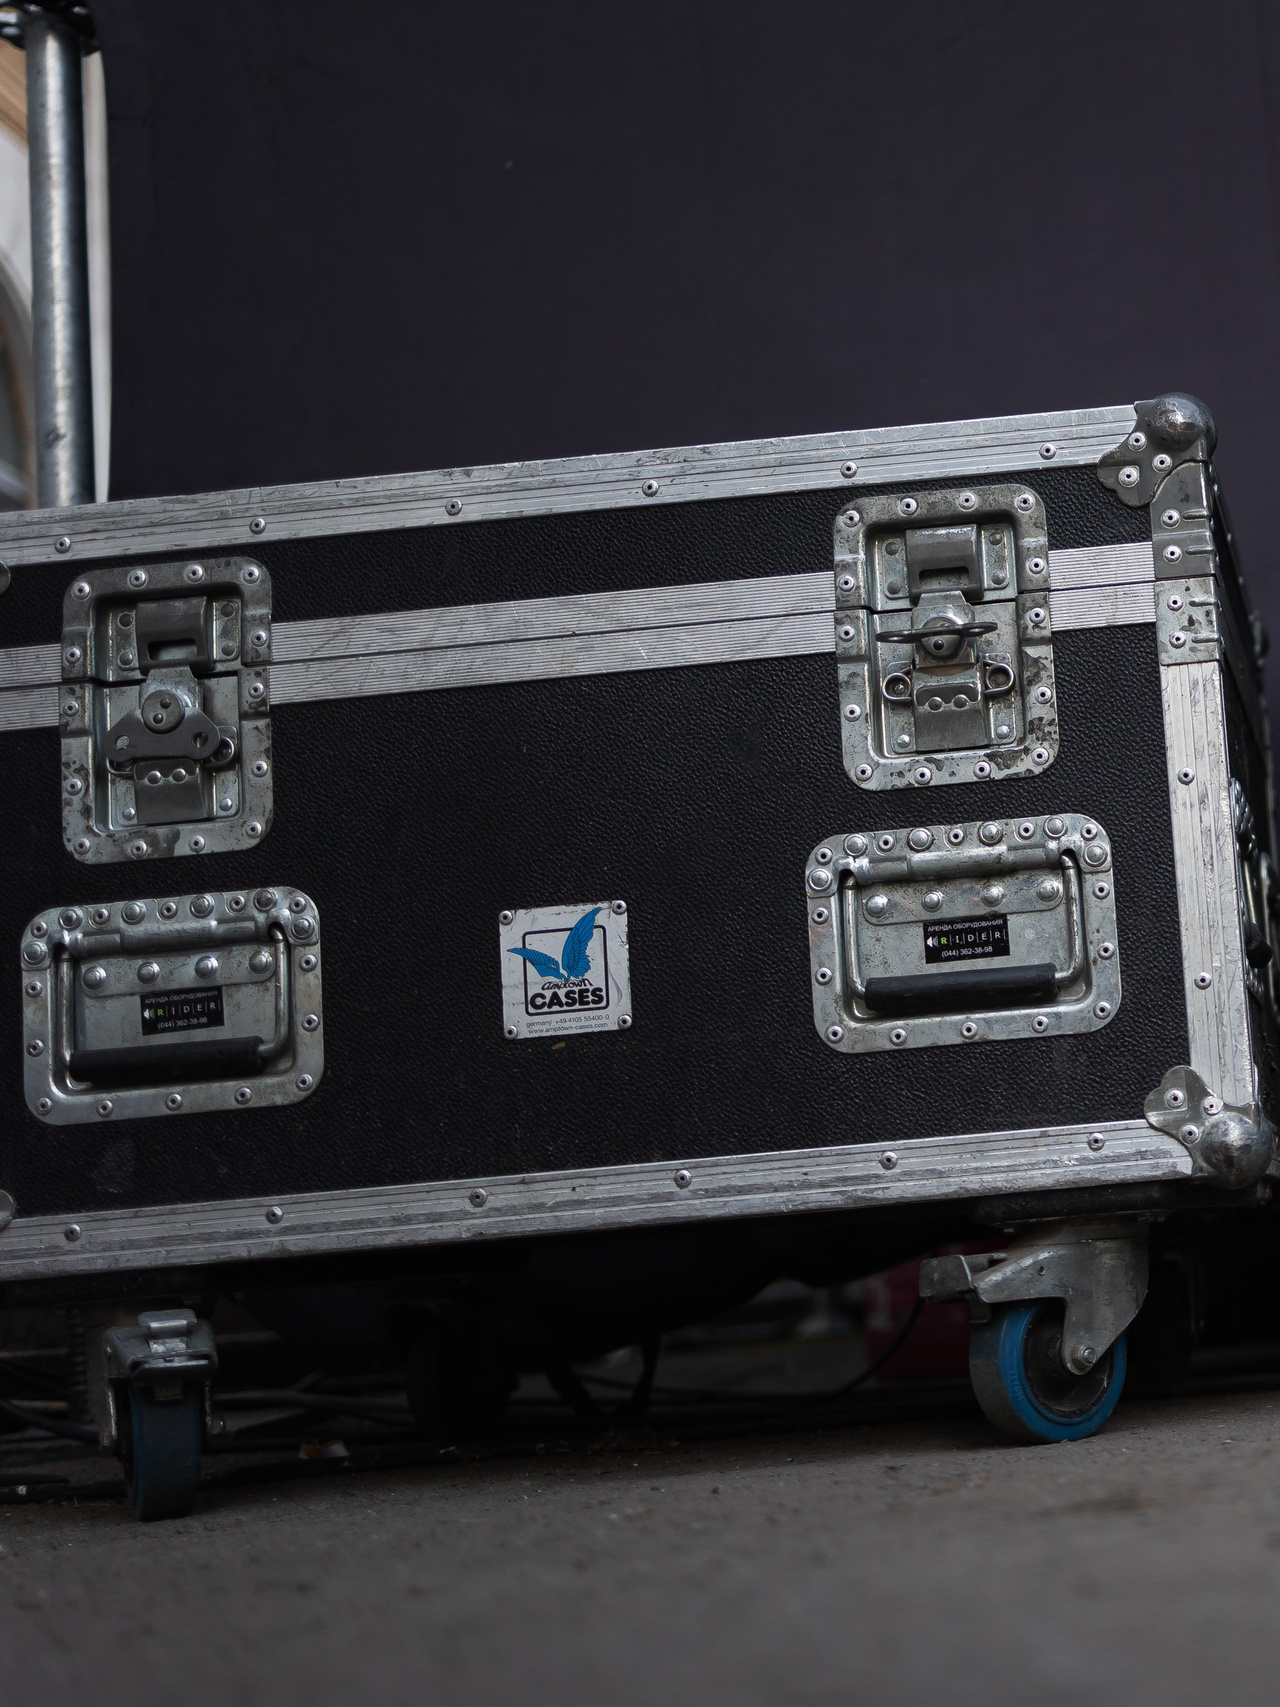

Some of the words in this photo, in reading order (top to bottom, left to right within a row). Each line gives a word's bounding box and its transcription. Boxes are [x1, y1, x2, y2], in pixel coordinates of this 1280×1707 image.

[927, 924, 952, 932] АРЕНДА
[940, 931, 1001, 944] RIDER
[941, 950, 959, 958] (044)
[960, 946, 993, 956] 362-38-98
[529, 987, 605, 1010] CASES
[157, 1002, 216, 1016] RIDER
